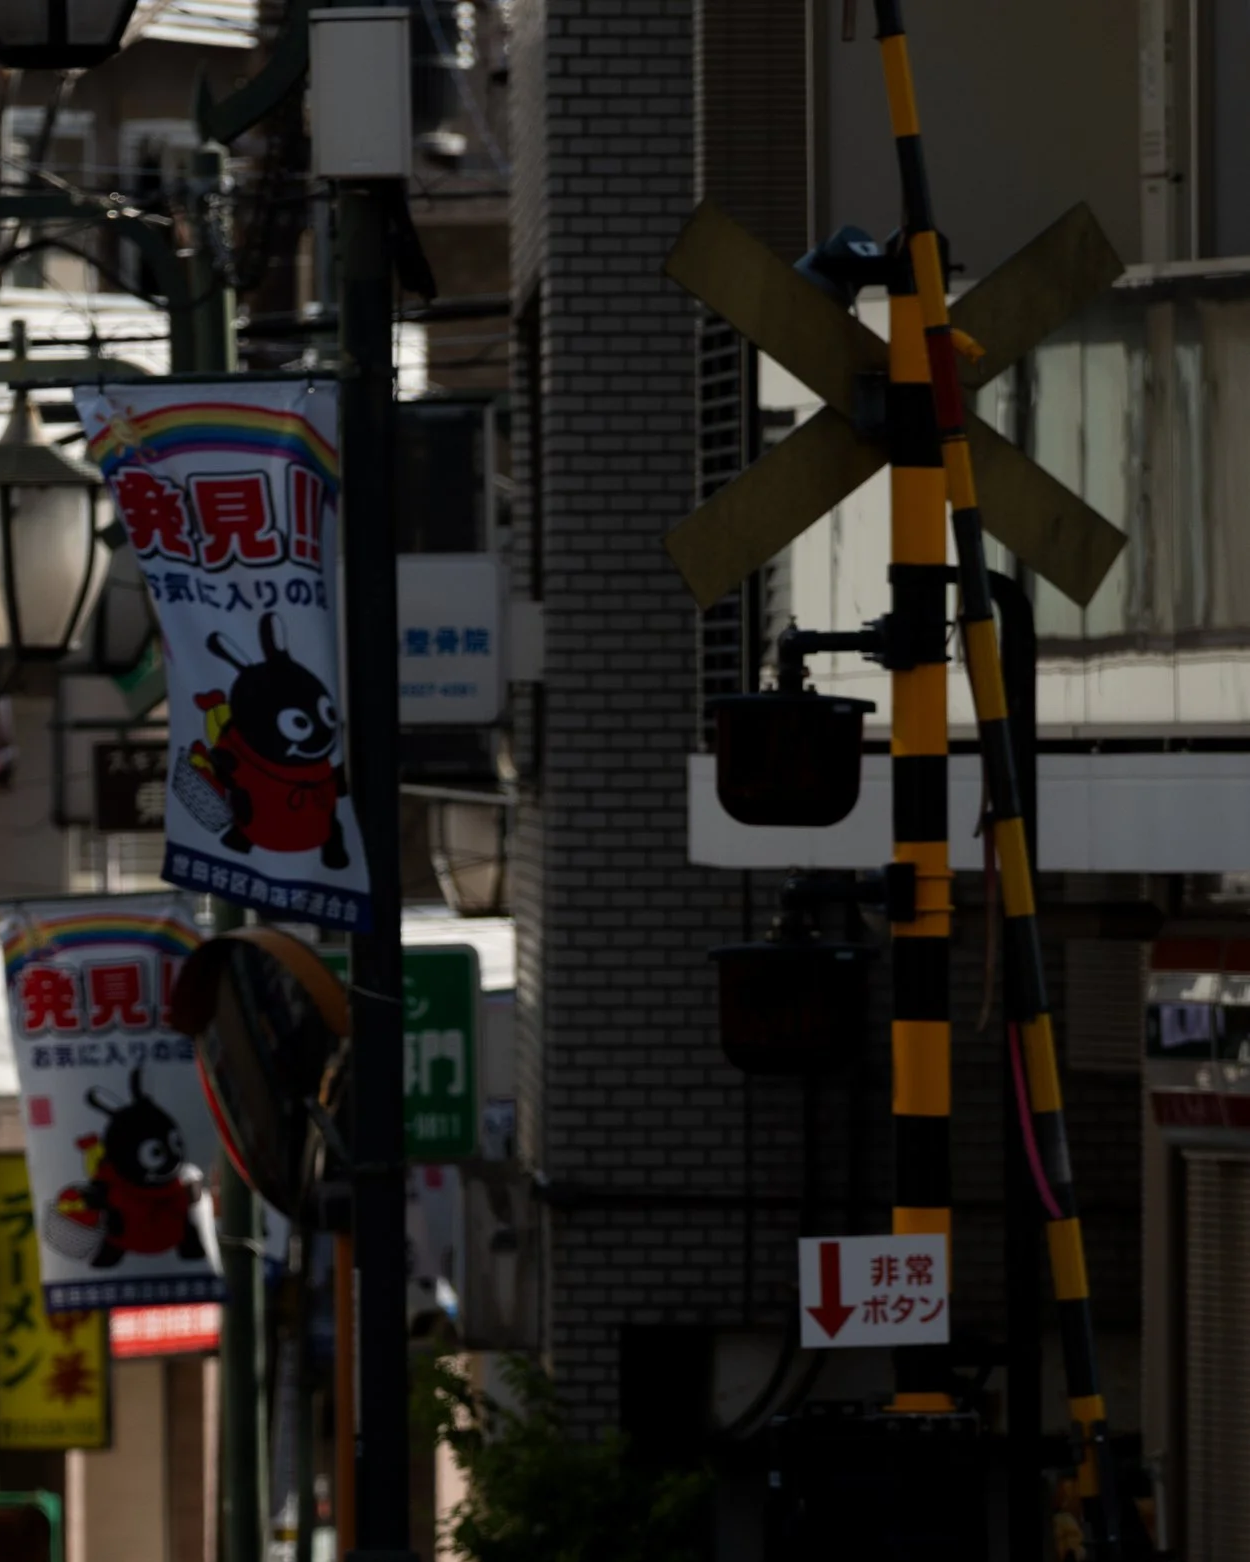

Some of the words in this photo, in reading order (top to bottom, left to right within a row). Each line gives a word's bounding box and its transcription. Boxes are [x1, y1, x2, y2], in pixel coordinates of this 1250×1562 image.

[23, 959, 174, 1031] 発見!
[870, 1254, 934, 1287] 非常
[863, 1295, 945, 1325] ボタン
